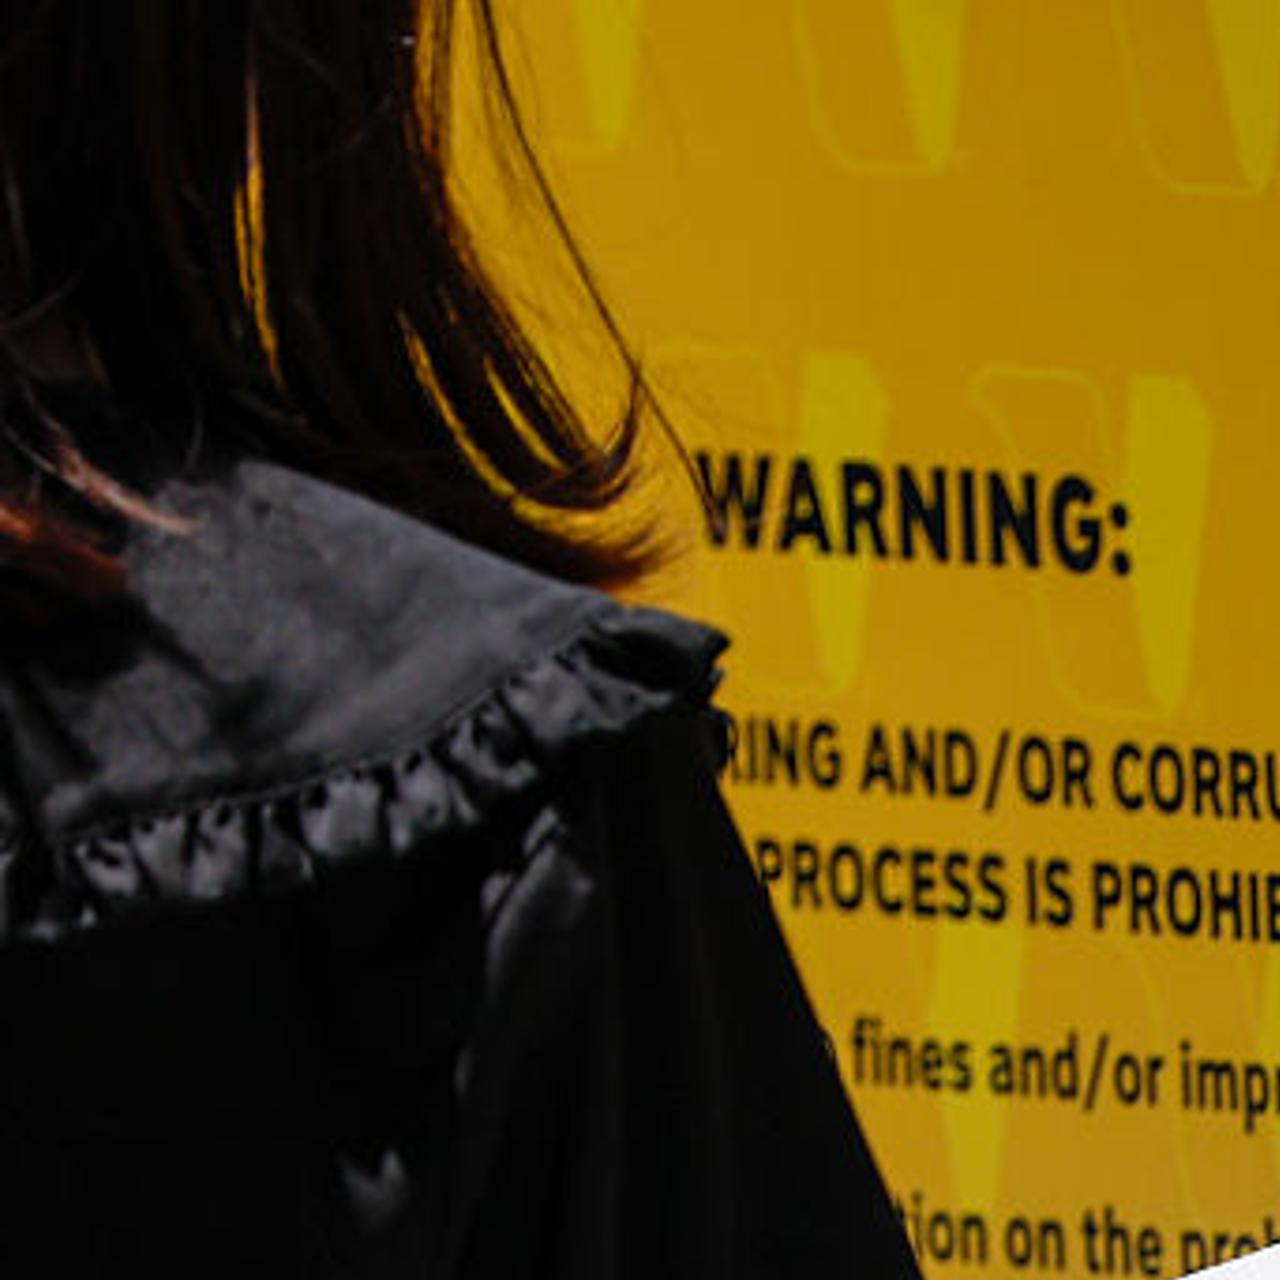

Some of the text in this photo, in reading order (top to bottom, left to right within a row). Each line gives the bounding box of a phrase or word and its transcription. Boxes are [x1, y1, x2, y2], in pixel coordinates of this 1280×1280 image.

[697, 453, 1131, 577] WARNING:
[861, 725, 1094, 811] AND/OR
[757, 838, 1012, 928] PROCESS
[1025, 857, 1074, 928] IS
[853, 1012, 977, 1097] fines
[990, 1034, 1165, 1110] and/or
[896, 1190, 988, 1266] ion
[1005, 1217, 1066, 1269] on
[1082, 1207, 1164, 1278] the
